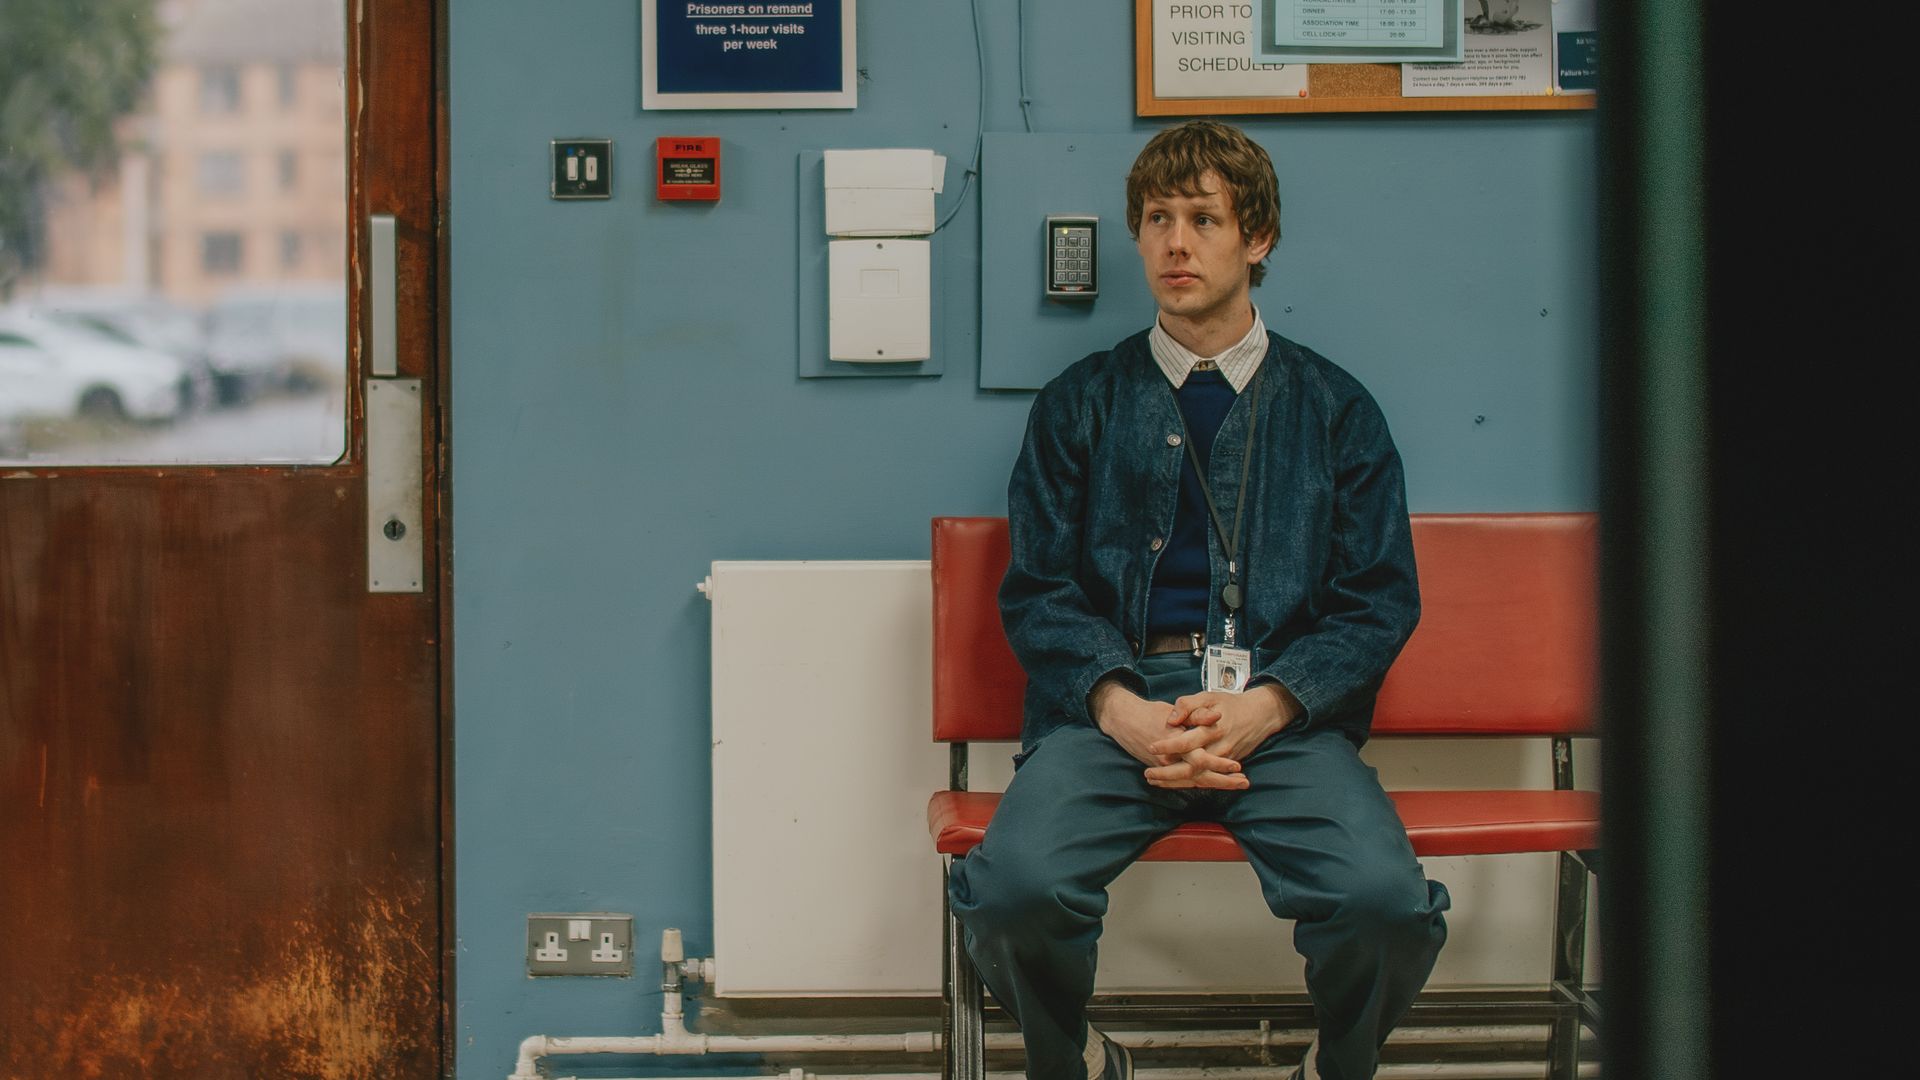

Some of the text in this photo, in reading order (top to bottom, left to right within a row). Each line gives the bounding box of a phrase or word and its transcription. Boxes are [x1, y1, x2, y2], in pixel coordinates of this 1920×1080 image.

[687, 3, 813, 14] Prisoners on remand
[1170, 4, 1252, 19] PRIOR TO
[696, 24, 804, 34] three 1-hour visits
[1172, 31, 1245, 45] VISITING
[724, 39, 778, 52] per week
